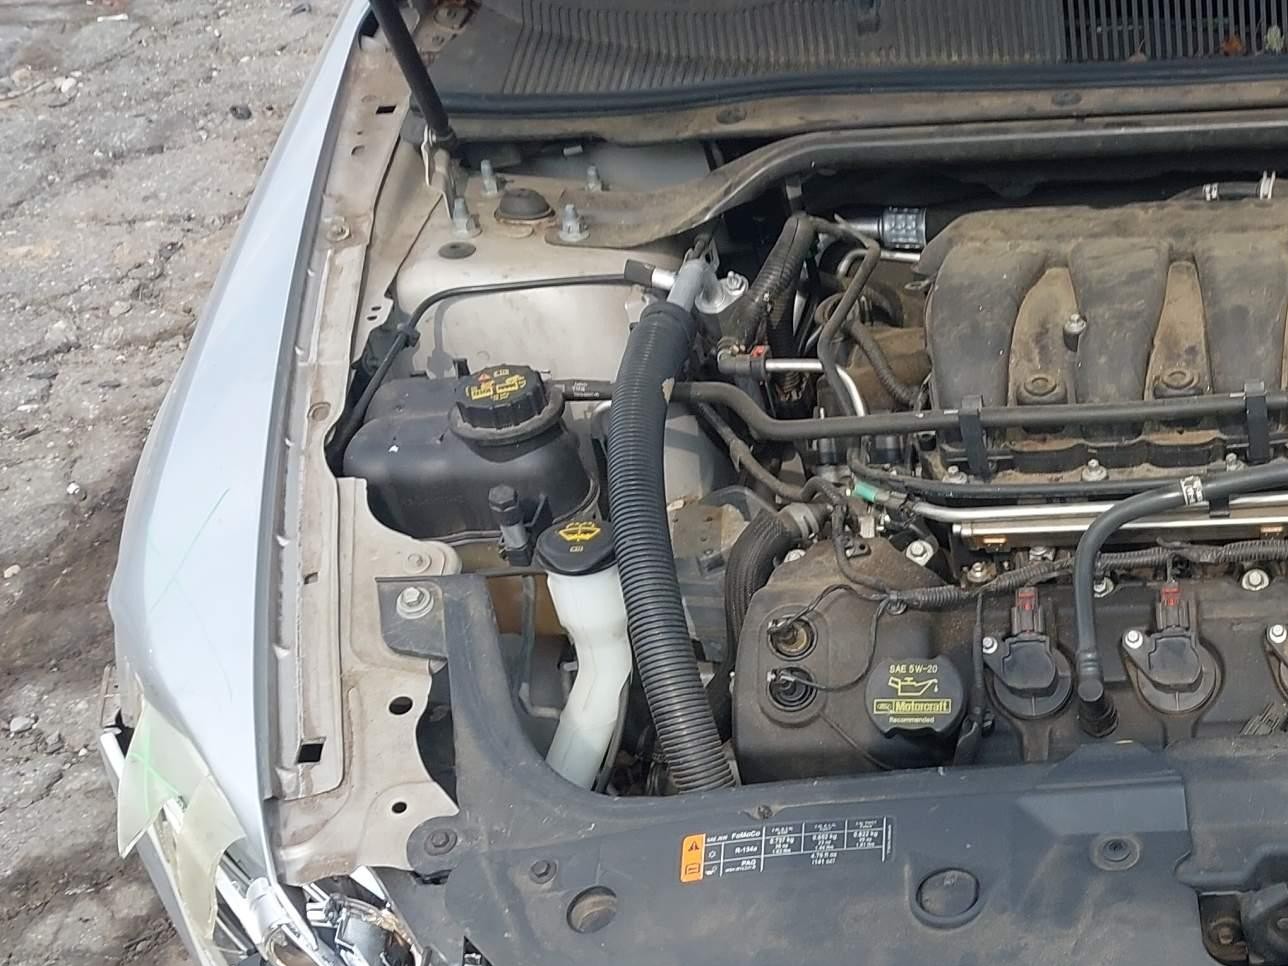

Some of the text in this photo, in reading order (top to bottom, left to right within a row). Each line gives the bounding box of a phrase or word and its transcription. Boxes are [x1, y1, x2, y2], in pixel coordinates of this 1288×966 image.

[889, 664, 938, 674] SAE 5W-20
[895, 701, 947, 712] Motorcraft
